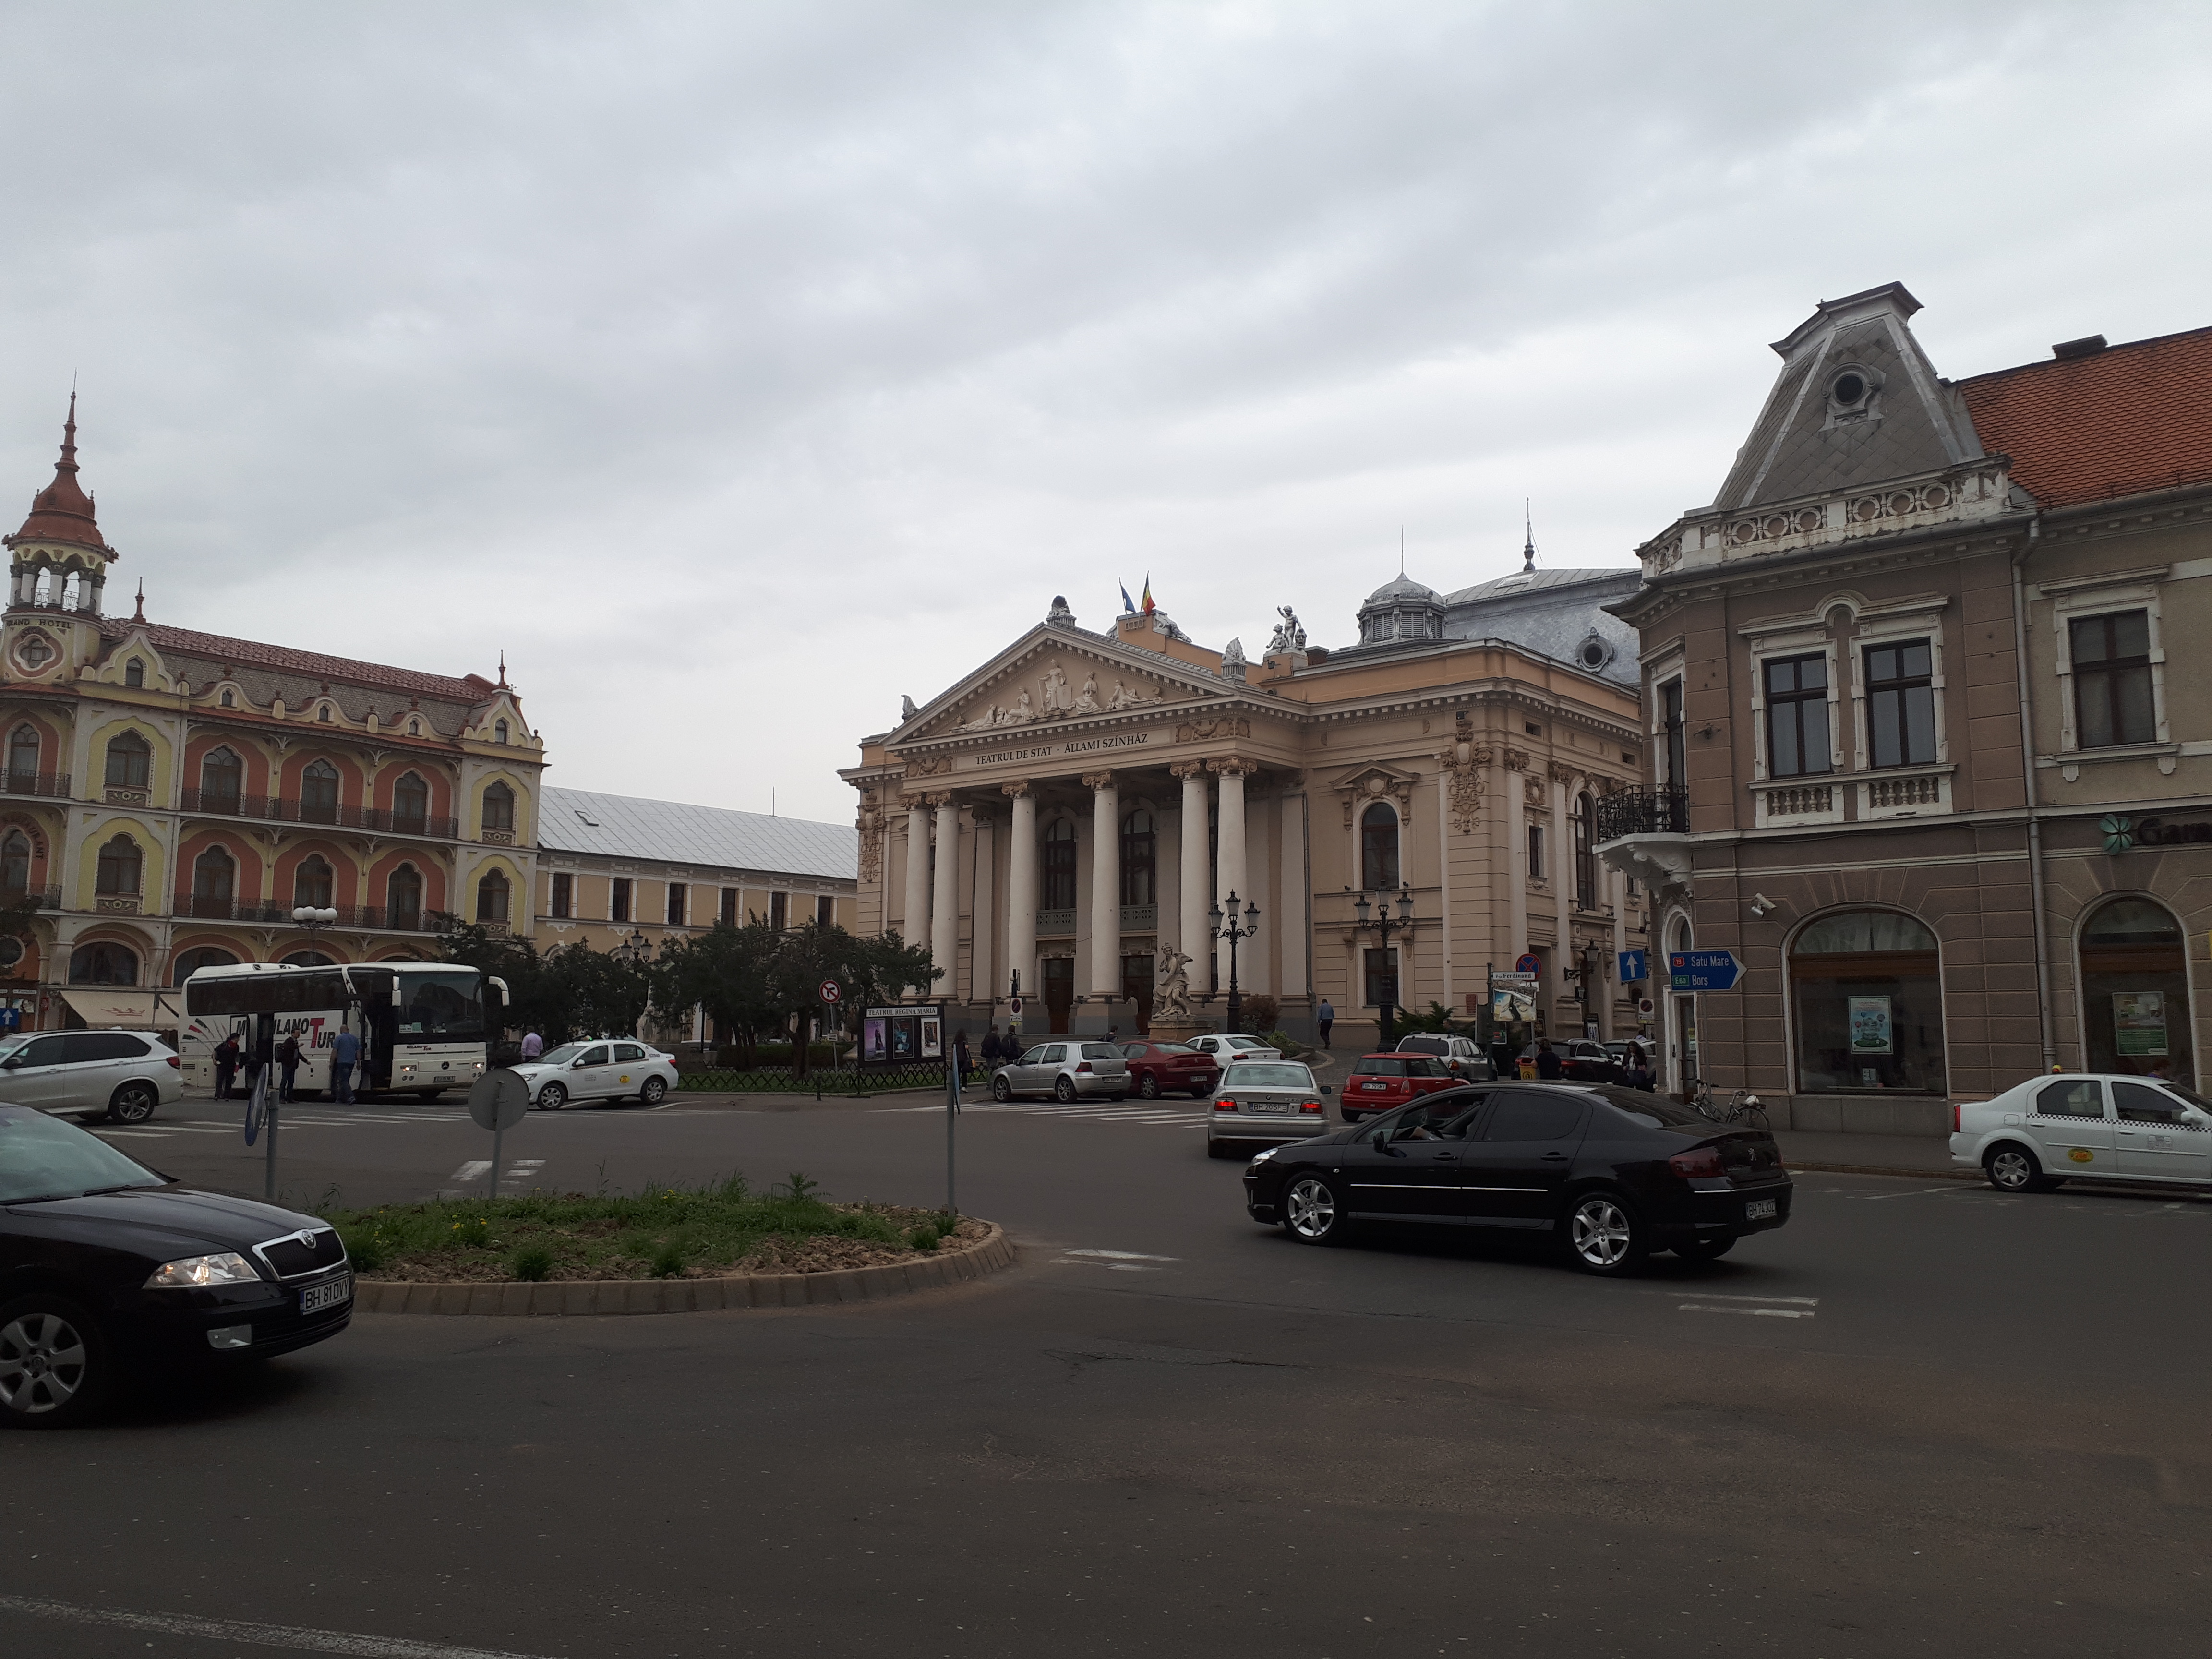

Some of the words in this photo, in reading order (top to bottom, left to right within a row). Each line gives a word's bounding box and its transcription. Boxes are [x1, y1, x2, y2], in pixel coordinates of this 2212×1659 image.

[39, 619, 71, 628] HOTEL
[1064, 740, 1100, 753] ÁLLAMI
[1103, 733, 1148, 748] SZÍNHÁZ
[975, 752, 1014, 765] TEATRUL
[1016, 750, 1028, 759] DE
[1031, 746, 1053, 757] STAT
[1691, 956, 1708, 967] Satu
[1710, 955, 1729, 966] Mare
[1749, 1205, 1757, 1216] BH
[306, 1288, 320, 1309] BH
